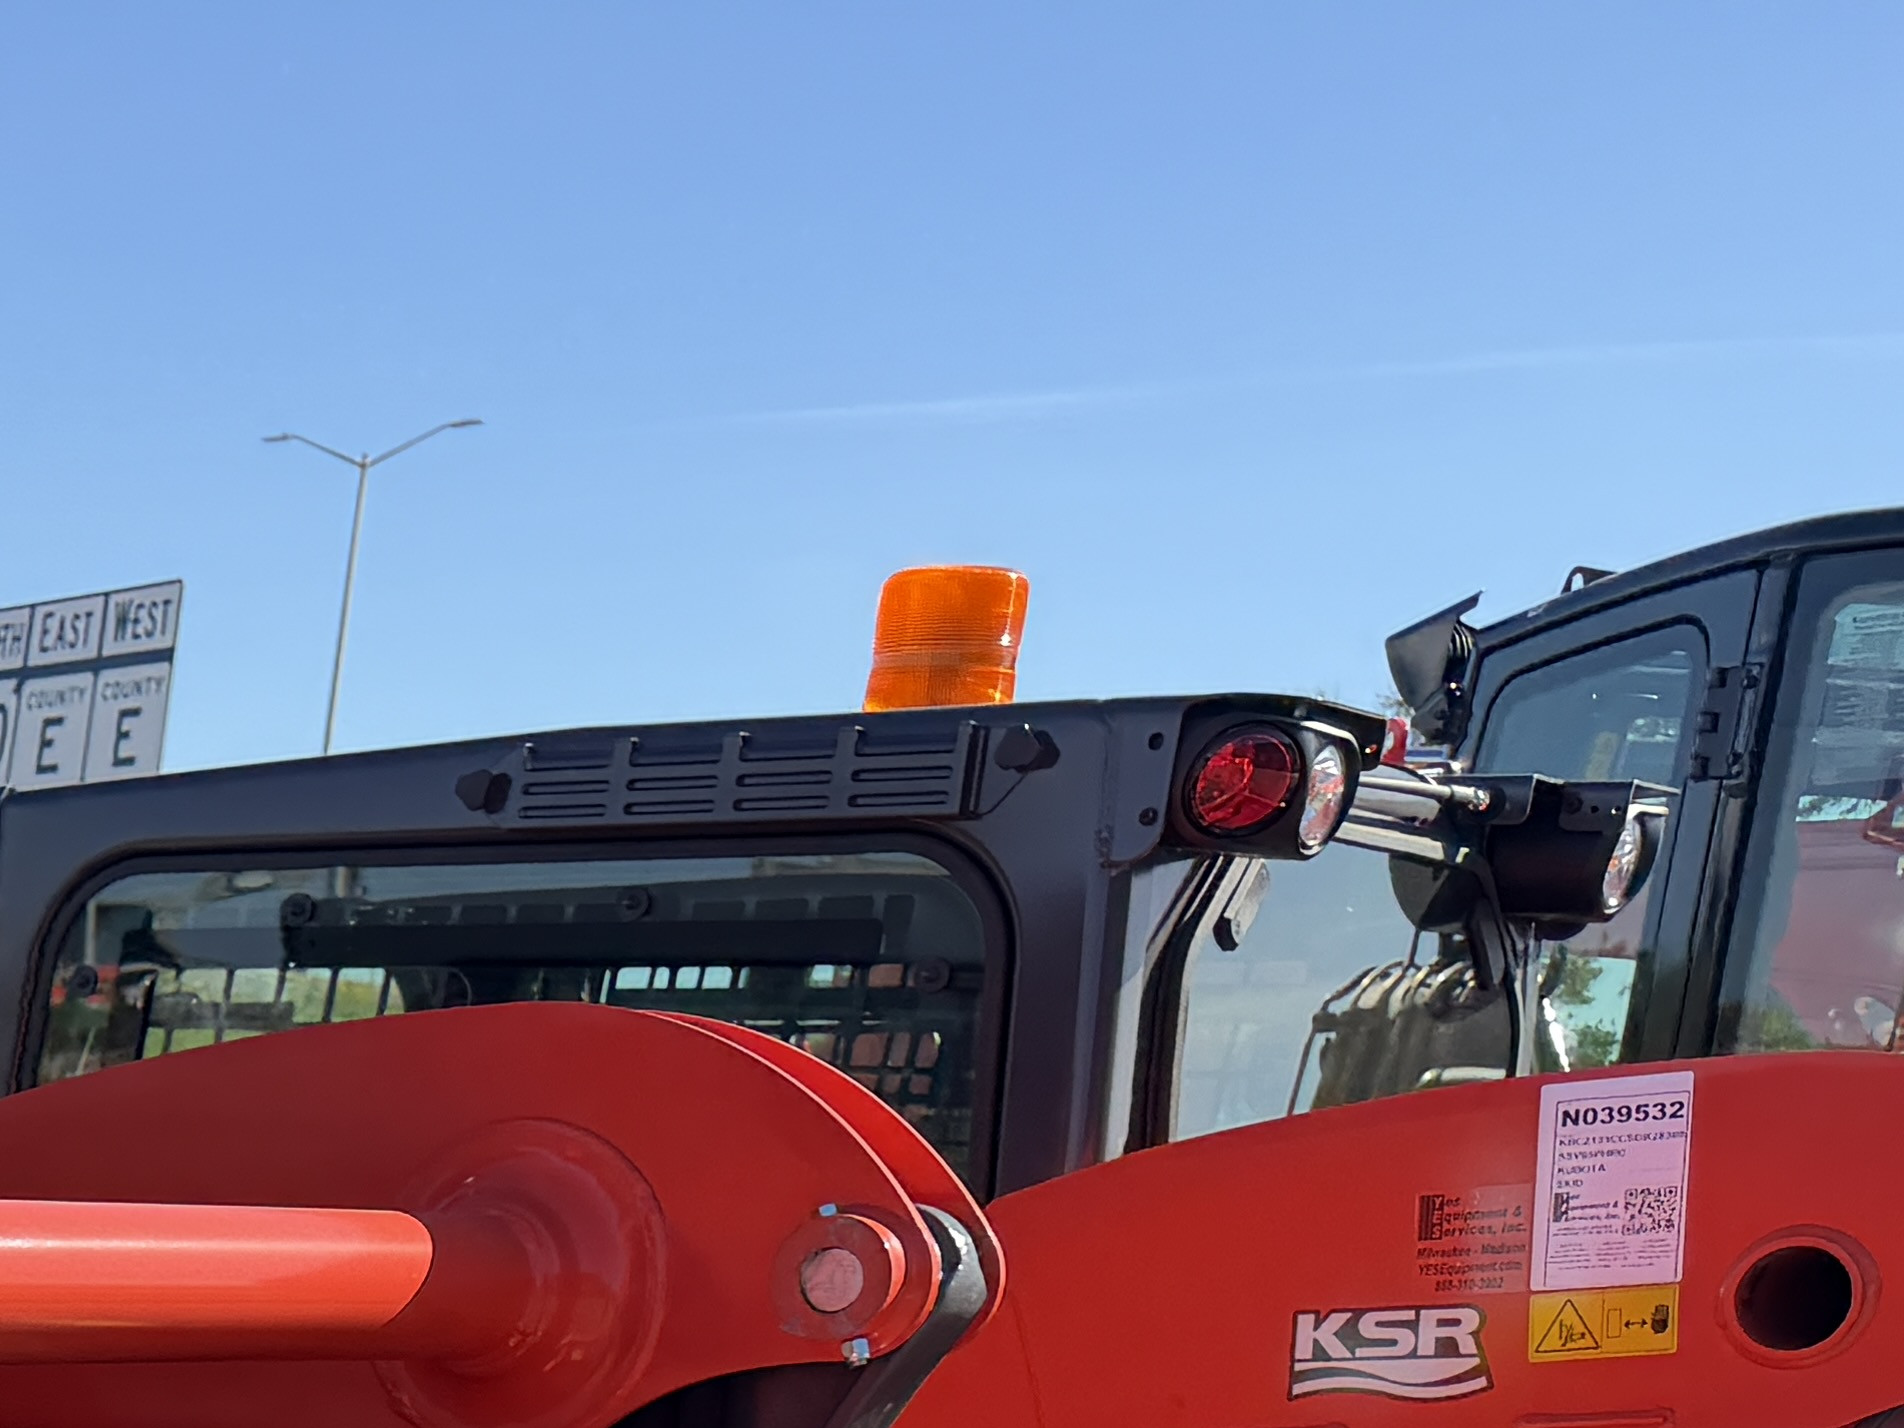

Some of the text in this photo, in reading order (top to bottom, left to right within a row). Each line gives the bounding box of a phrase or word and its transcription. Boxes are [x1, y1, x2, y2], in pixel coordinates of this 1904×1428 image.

[39, 611, 94, 654] EAST
[113, 598, 172, 642] WEST
[26, 685, 88, 711] COUNTY
[100, 675, 166, 702] COUNTY
[36, 715, 64, 775] E
[112, 706, 142, 767] E
[1561, 1101, 1685, 1127] N039532
[1294, 1307, 1481, 1360] KSR
